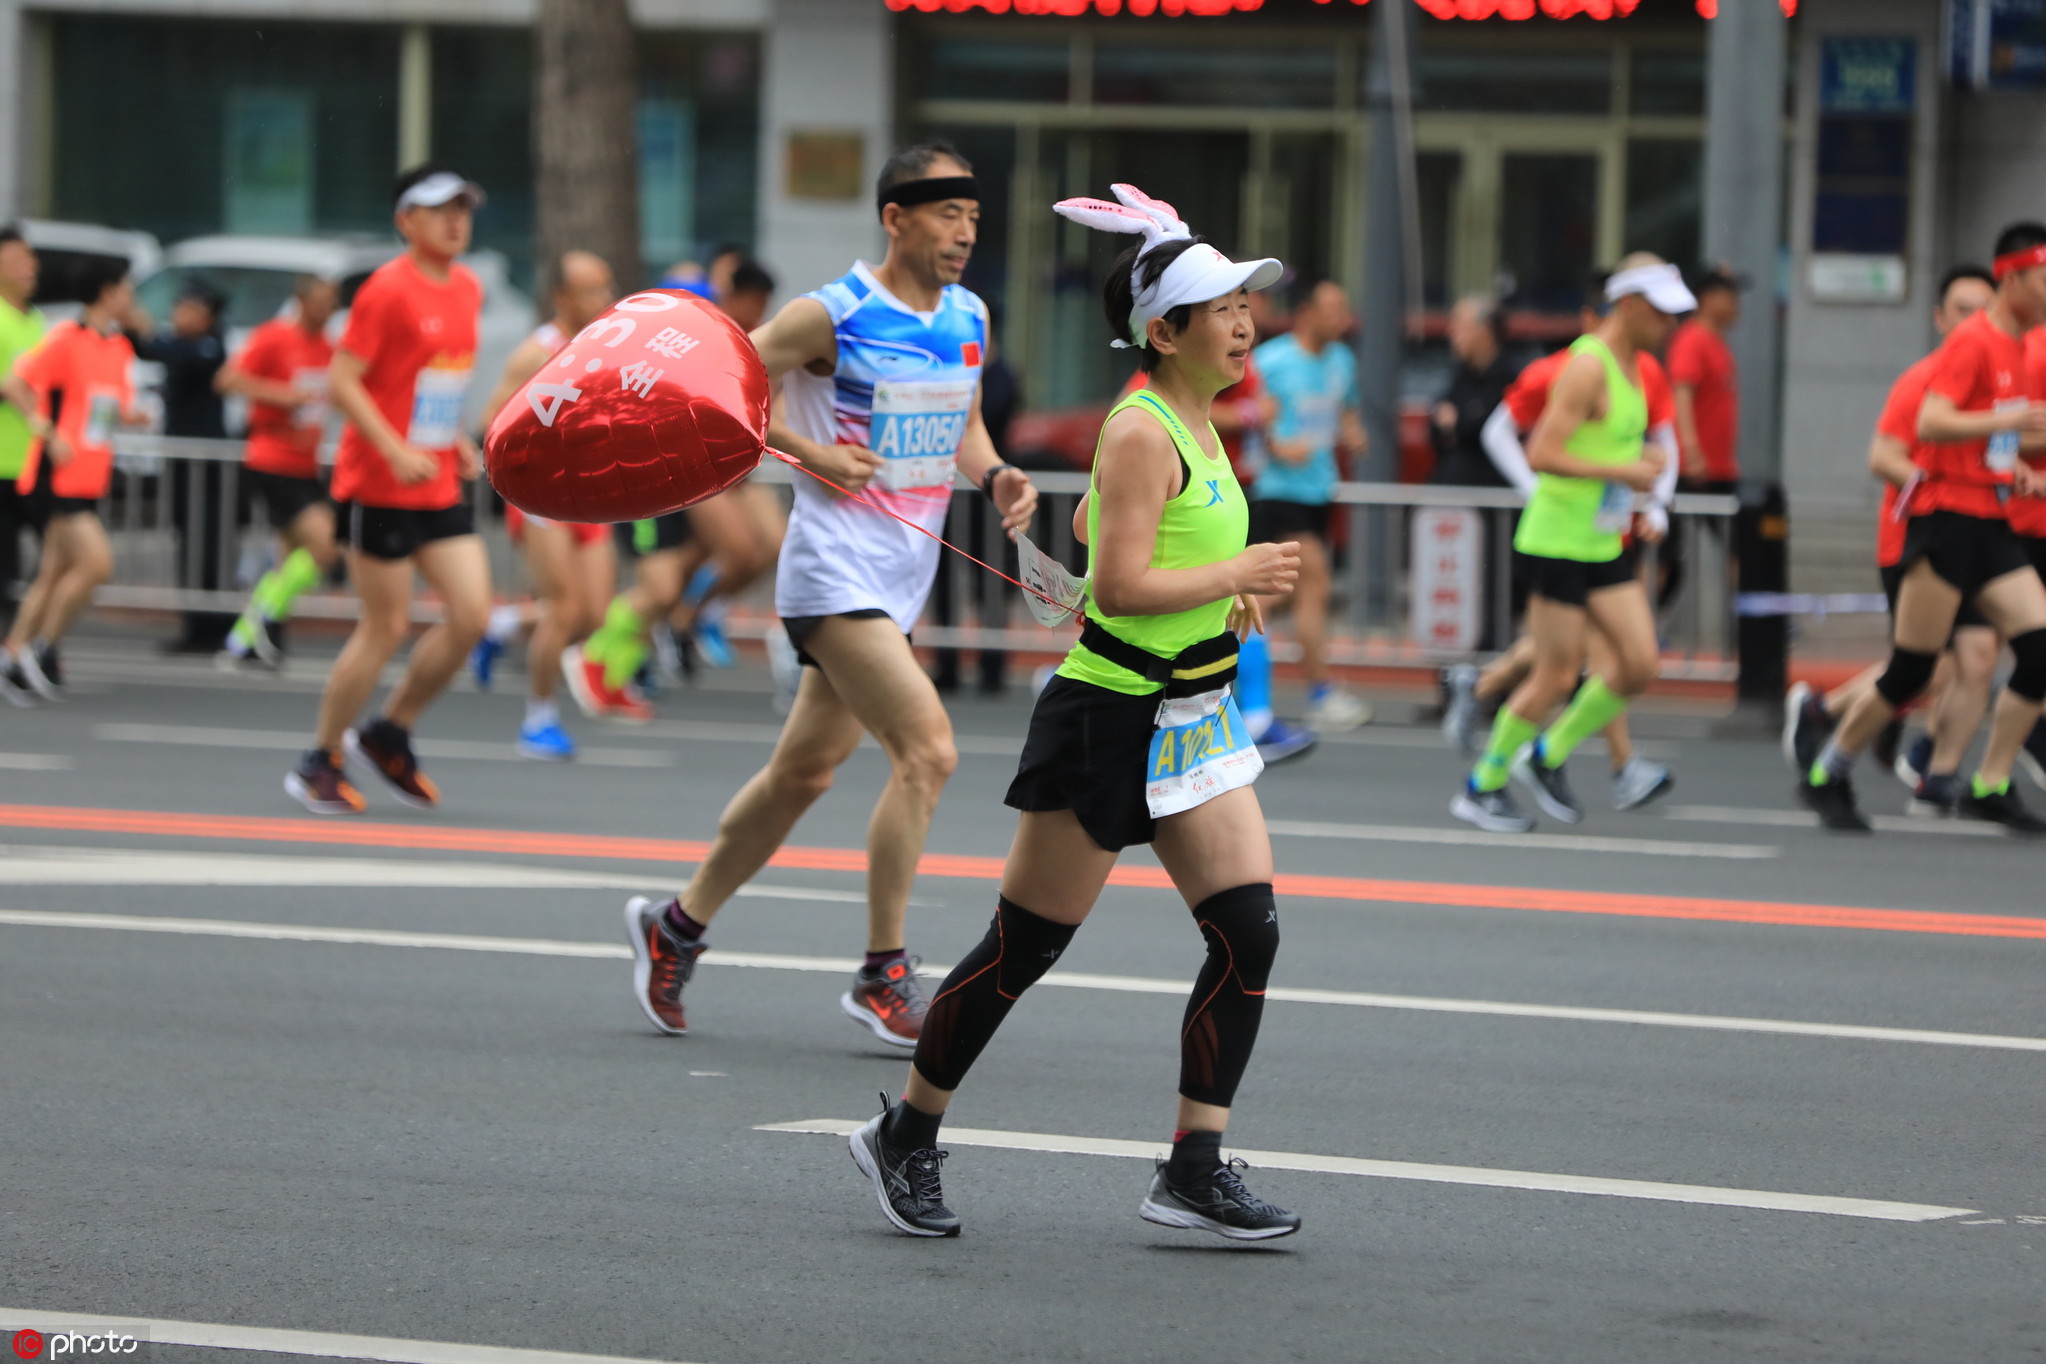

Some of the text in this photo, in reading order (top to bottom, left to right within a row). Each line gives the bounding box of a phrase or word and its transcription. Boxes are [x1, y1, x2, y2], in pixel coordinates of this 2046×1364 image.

[526, 292, 680, 427] 4:30
[619, 327, 700, 399] 全程
[877, 413, 963, 457] A13050
